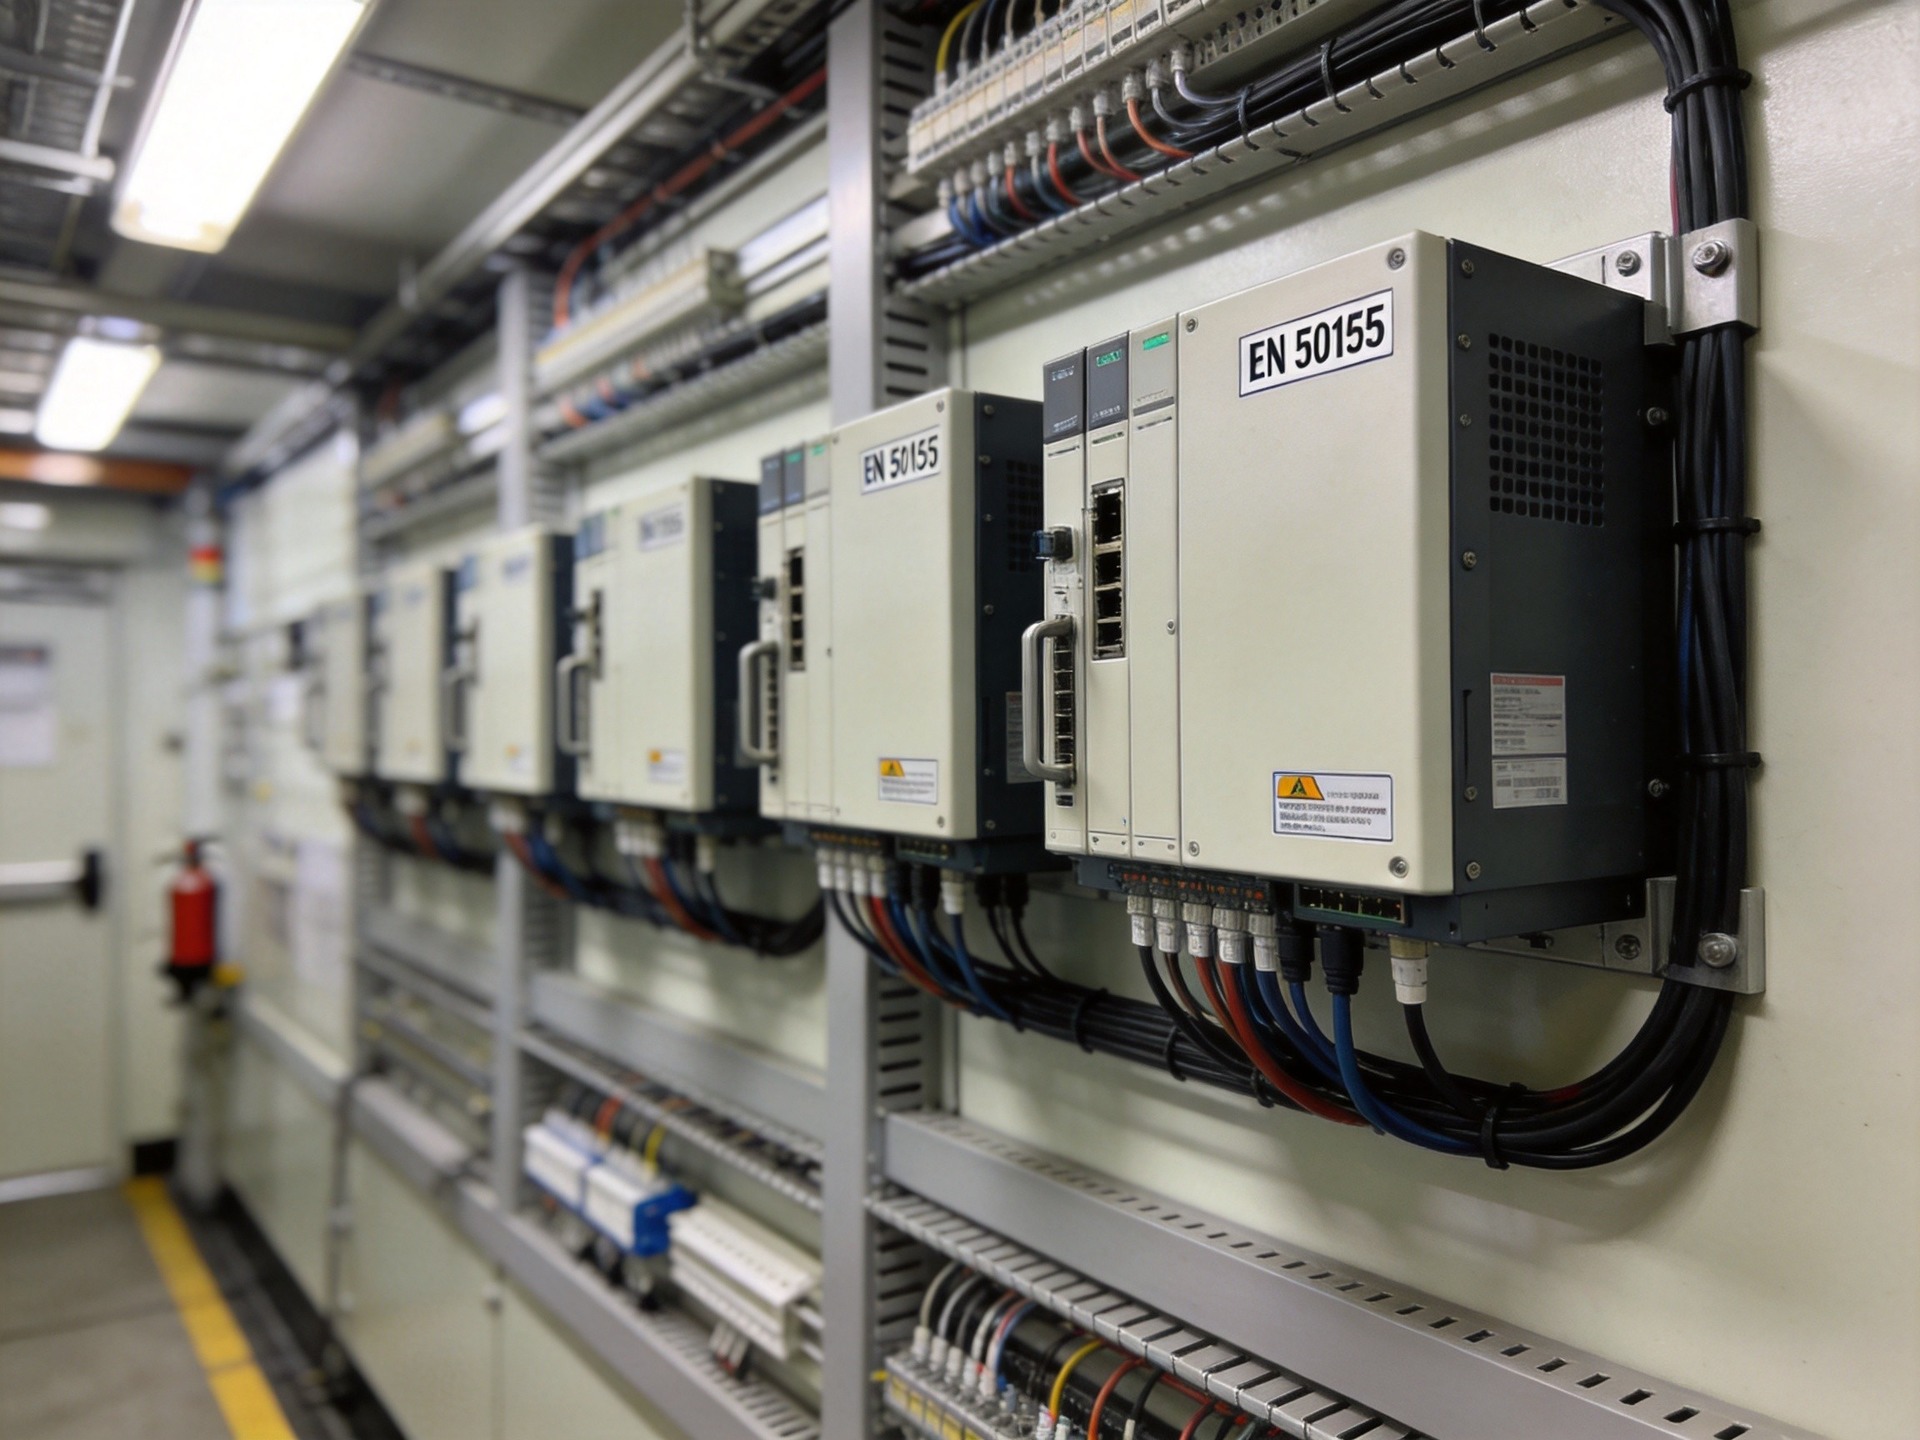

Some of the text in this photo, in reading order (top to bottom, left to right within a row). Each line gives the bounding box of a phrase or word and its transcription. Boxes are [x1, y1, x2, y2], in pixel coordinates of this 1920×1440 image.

[1249, 303, 1385, 382] EN 50155
[864, 433, 938, 485] EN 50155
